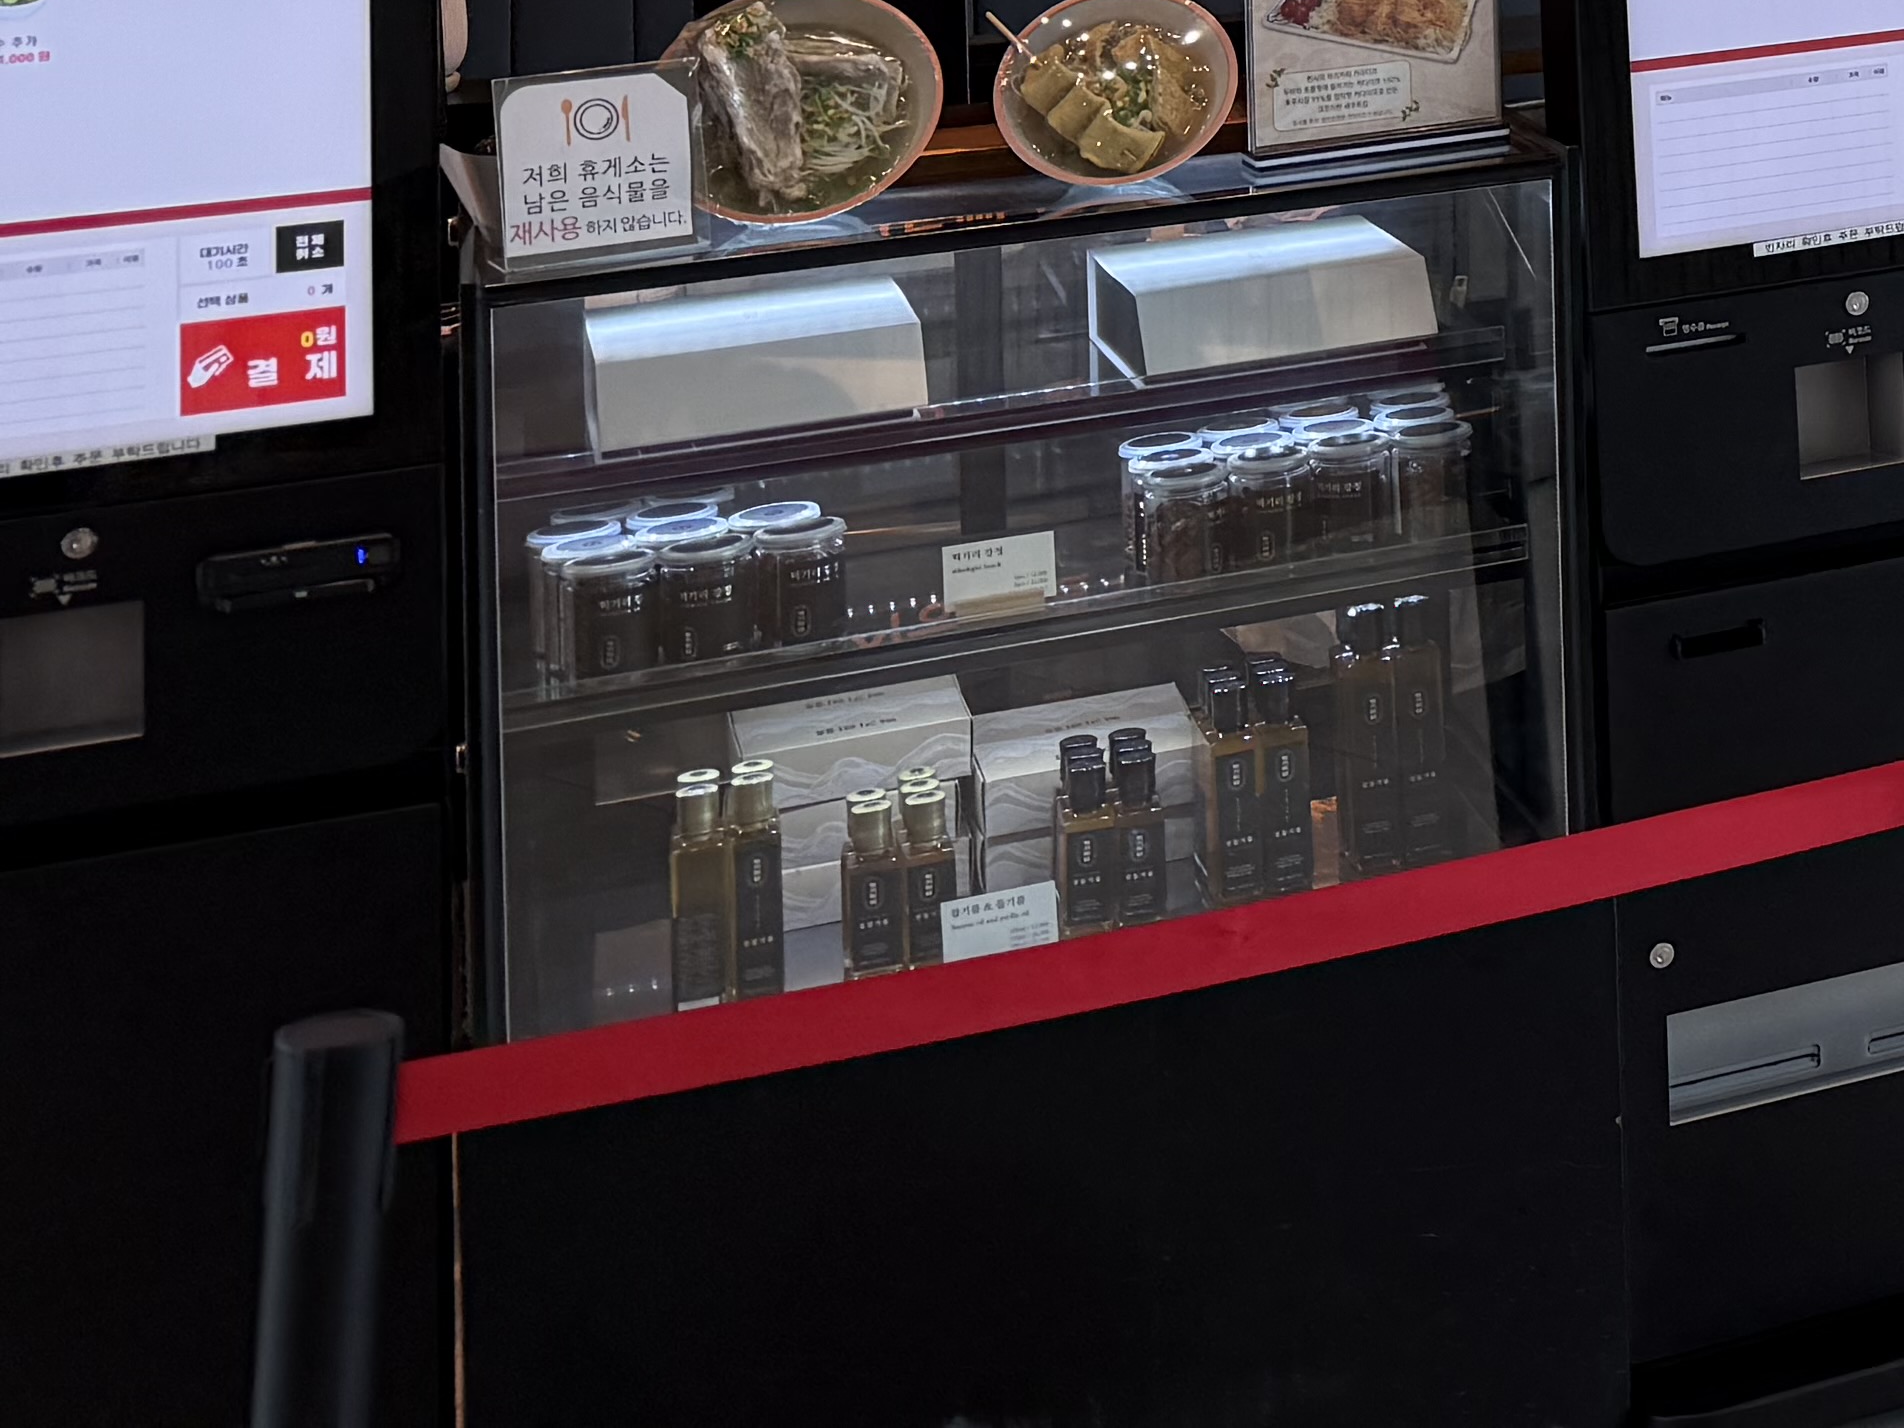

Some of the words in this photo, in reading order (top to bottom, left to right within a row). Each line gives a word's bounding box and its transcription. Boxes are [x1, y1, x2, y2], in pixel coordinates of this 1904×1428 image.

[522, 162, 568, 187] 저희
[578, 153, 670, 182] 휴게소는
[523, 189, 570, 215] 남은
[578, 178, 670, 209] 음식물을
[510, 216, 582, 246] 재사용
[586, 217, 618, 235] 하지
[300, 325, 337, 348] 0원
[246, 357, 279, 387] 결
[305, 350, 338, 381] 제
